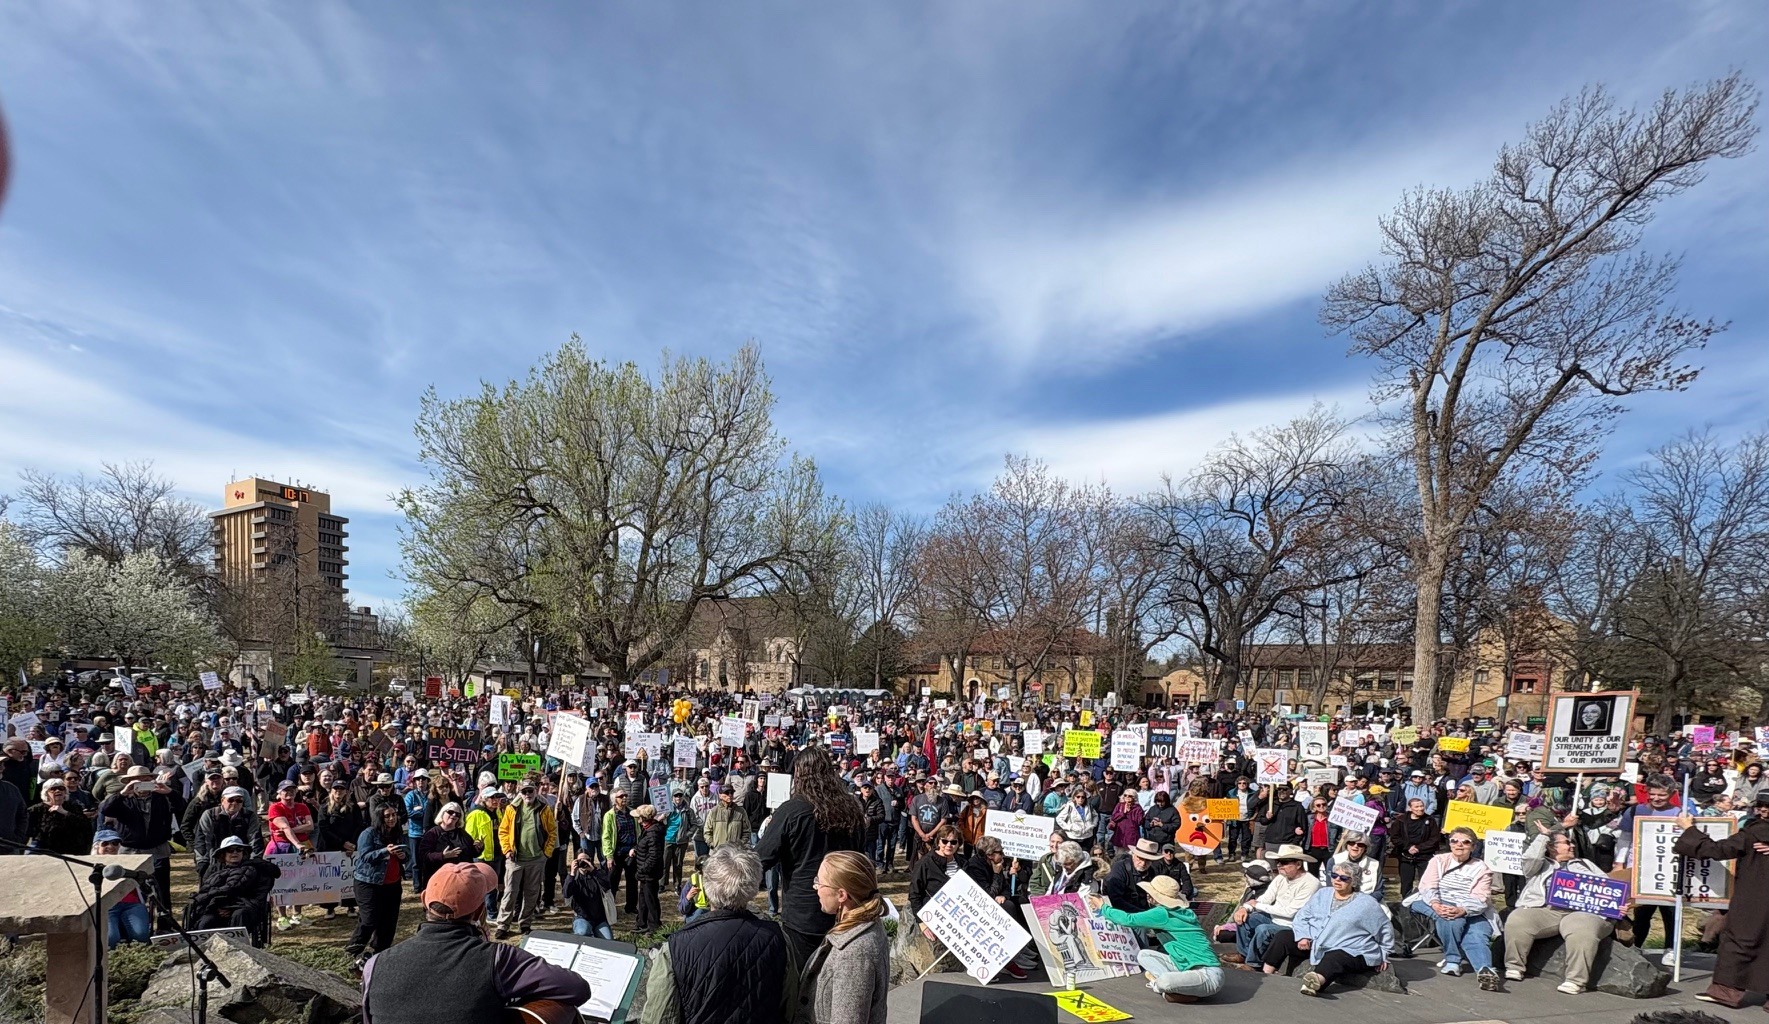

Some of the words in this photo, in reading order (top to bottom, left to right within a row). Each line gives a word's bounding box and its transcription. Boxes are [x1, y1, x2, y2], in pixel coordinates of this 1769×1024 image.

[284, 487, 309, 503] 10:17
[429, 726, 476, 740] TRUMP
[429, 745, 480, 763] EPSTEIN
[1151, 744, 1173, 758] NO!
[1450, 803, 1487, 816] IMPEACH
[1331, 813, 1343, 824] ALL
[1464, 814, 1493, 826] TRUMP
[990, 827, 1030, 837] LAWLESSNESS
[1016, 842, 1035, 850] WOULD
[312, 854, 332, 865] ALL
[1654, 824, 1666, 891] JUSTICE
[1556, 877, 1576, 888] NO
[1579, 882, 1622, 898] KINGS
[1553, 890, 1619, 910] AMERICA
[956, 894, 980, 917] STAND
[979, 916, 990, 927] UP
[989, 926, 1006, 942] FOR
[934, 909, 946, 923] WE
[946, 922, 971, 947] DON'T
[970, 946, 990, 966] BOW
[1097, 931, 1128, 945] STUPID
[935, 924, 946, 936] TO
[944, 935, 952, 943] A
[951, 942, 975, 966] KING!
[1097, 949, 1123, 961] VOTE
